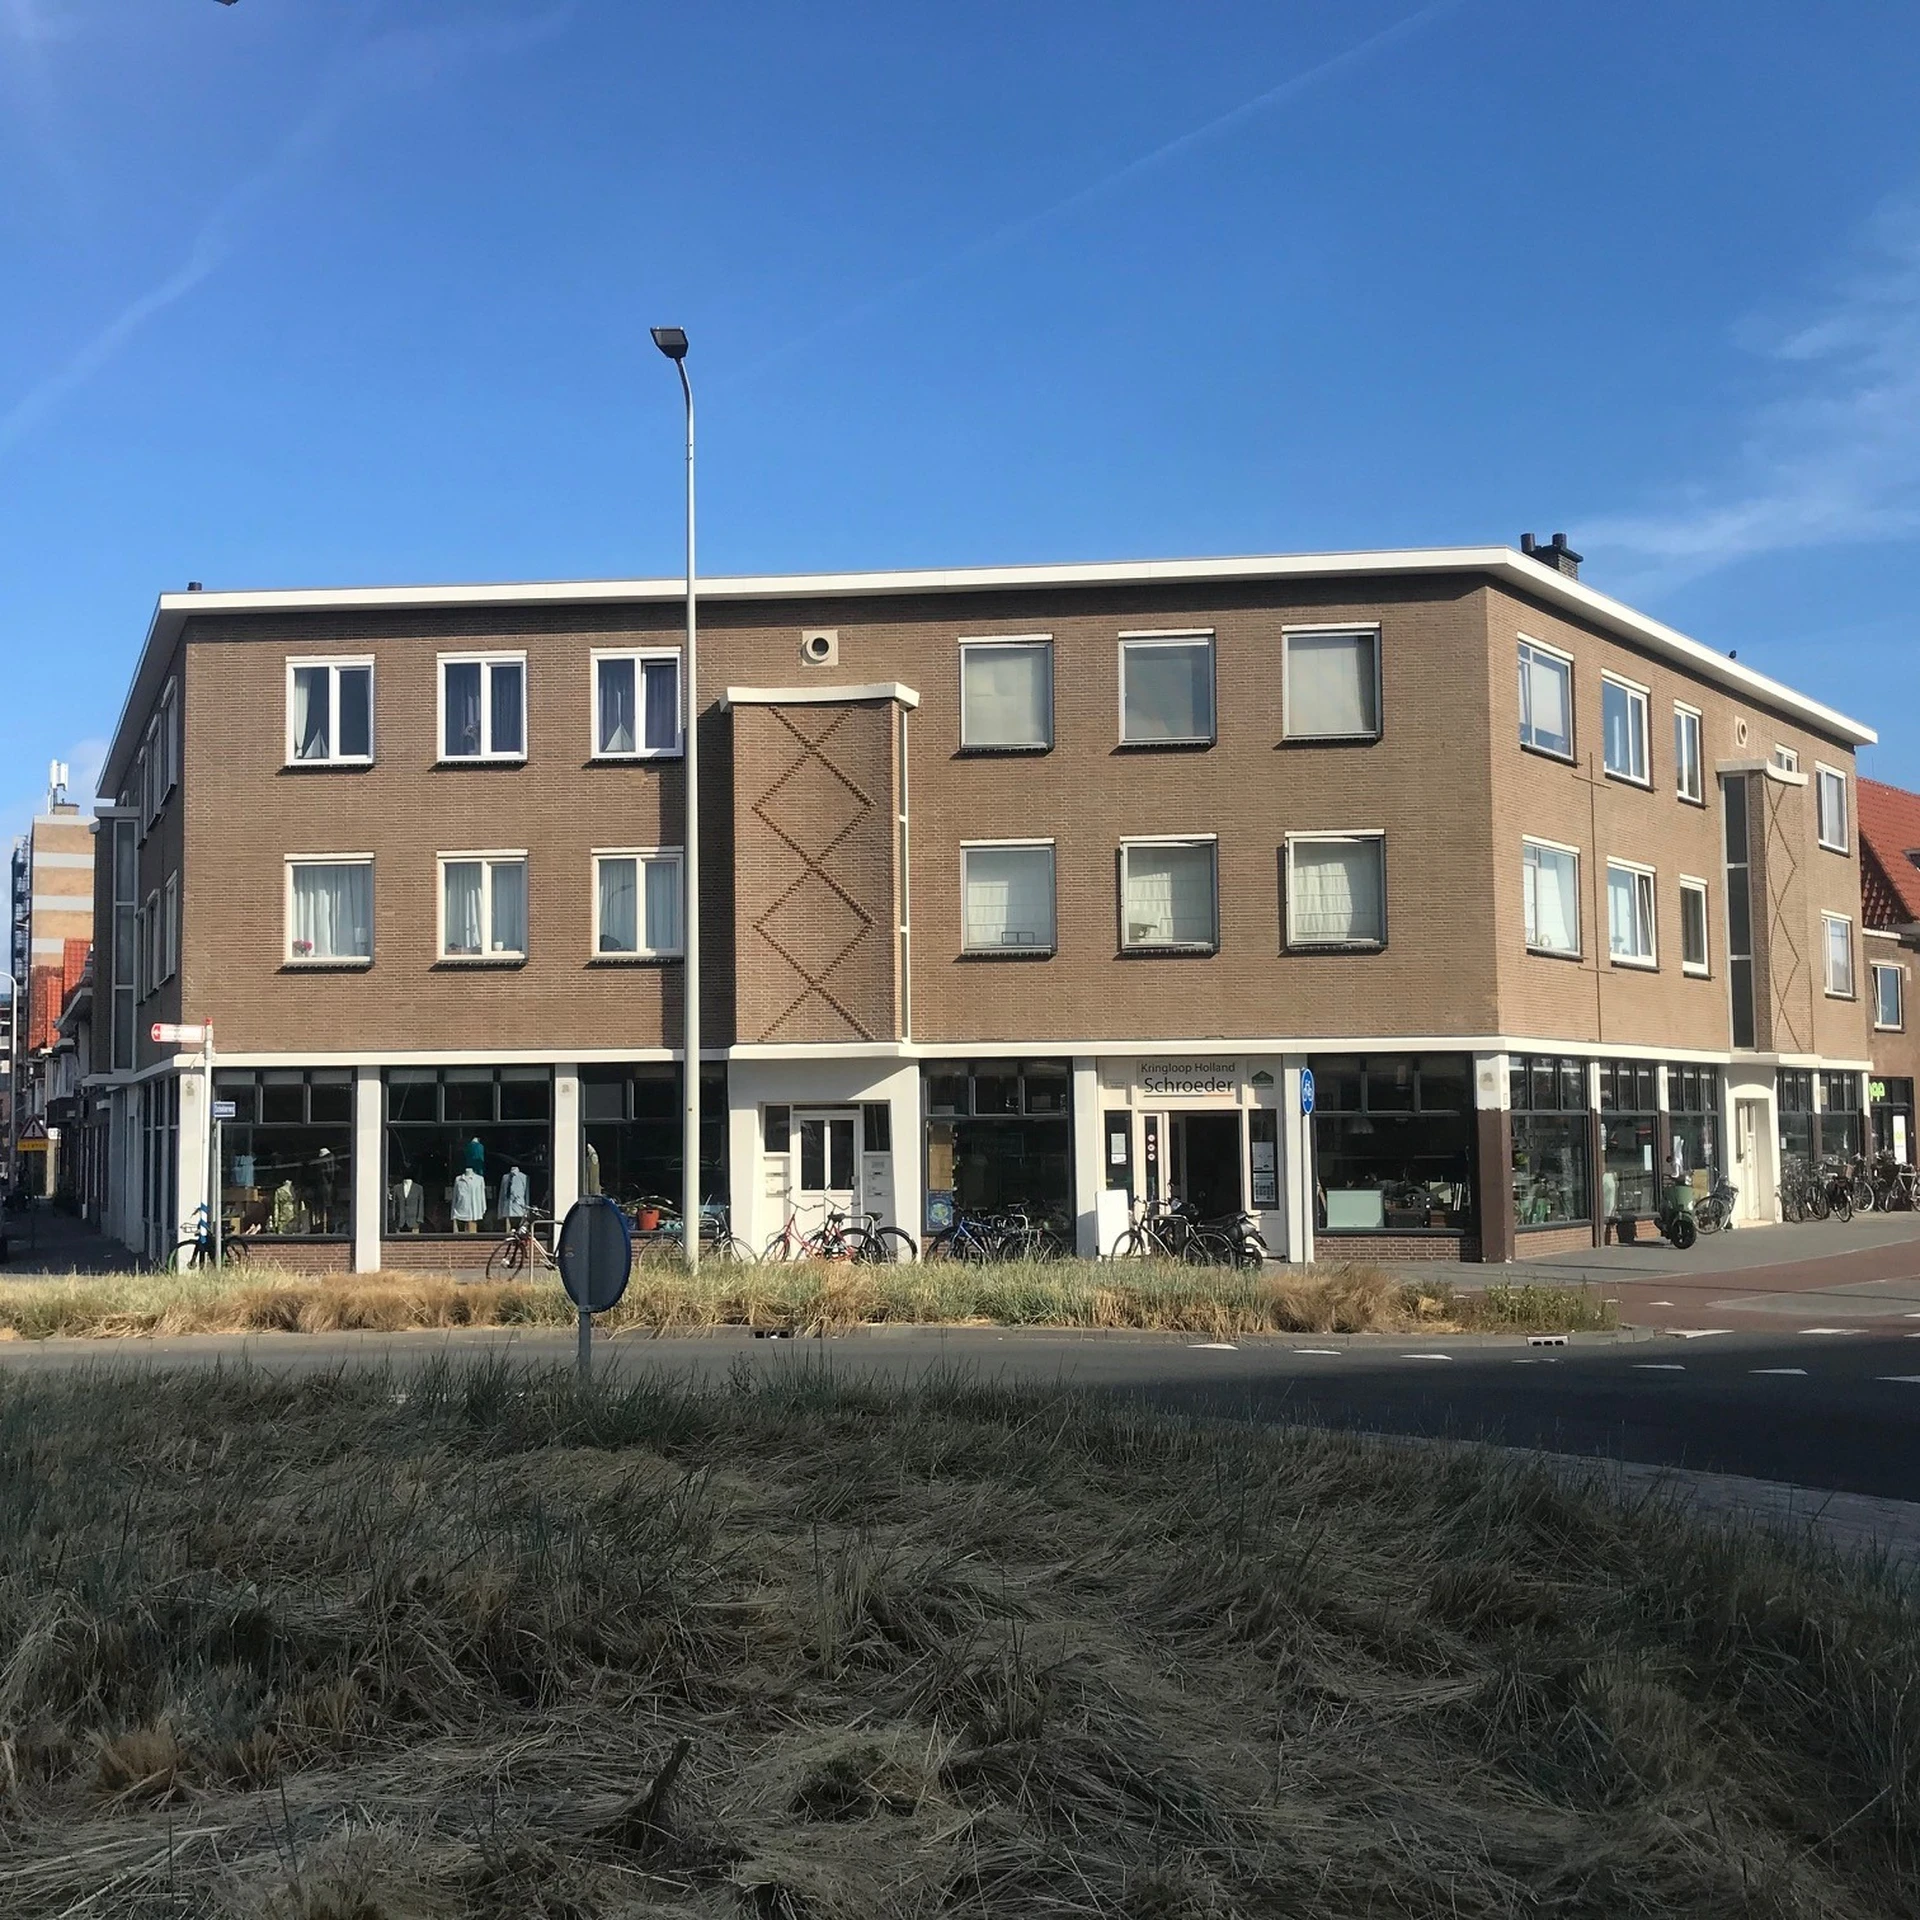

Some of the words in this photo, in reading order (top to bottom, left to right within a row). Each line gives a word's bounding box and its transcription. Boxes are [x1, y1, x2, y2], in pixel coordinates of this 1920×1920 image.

[1141, 1063, 1192, 1075] Kringloop
[1195, 1062, 1235, 1072] Holland
[1144, 1076, 1234, 1093] Schroeder
